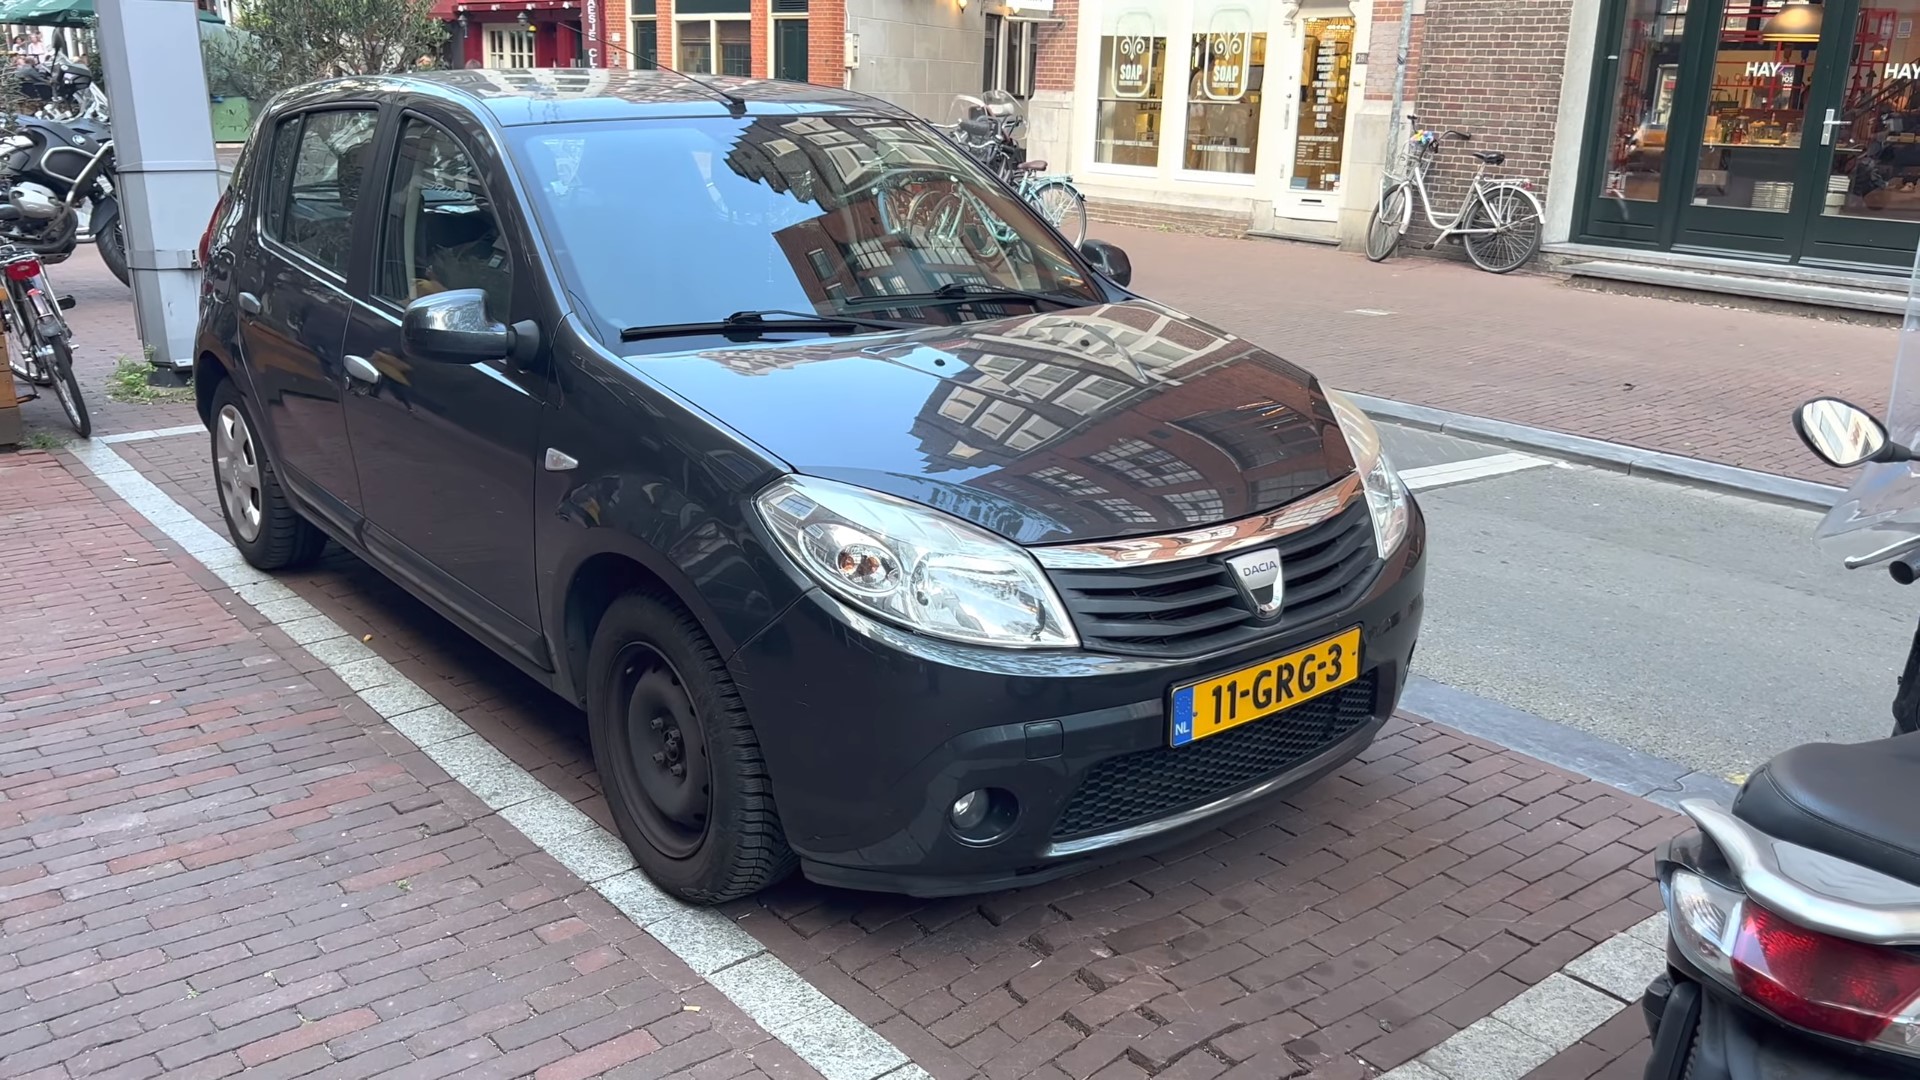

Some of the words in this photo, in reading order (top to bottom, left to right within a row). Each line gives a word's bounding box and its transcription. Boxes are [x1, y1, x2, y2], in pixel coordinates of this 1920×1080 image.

[588, 48, 598, 69] CL
[1119, 64, 1143, 80] SOAP
[1213, 65, 1239, 82] SOAP
[1744, 61, 1781, 77] HAY
[1883, 63, 1920, 80] HAY
[1243, 560, 1277, 577] DACIA
[1211, 643, 1342, 724] 11-GRG-3
[1175, 721, 1190, 736] NL
